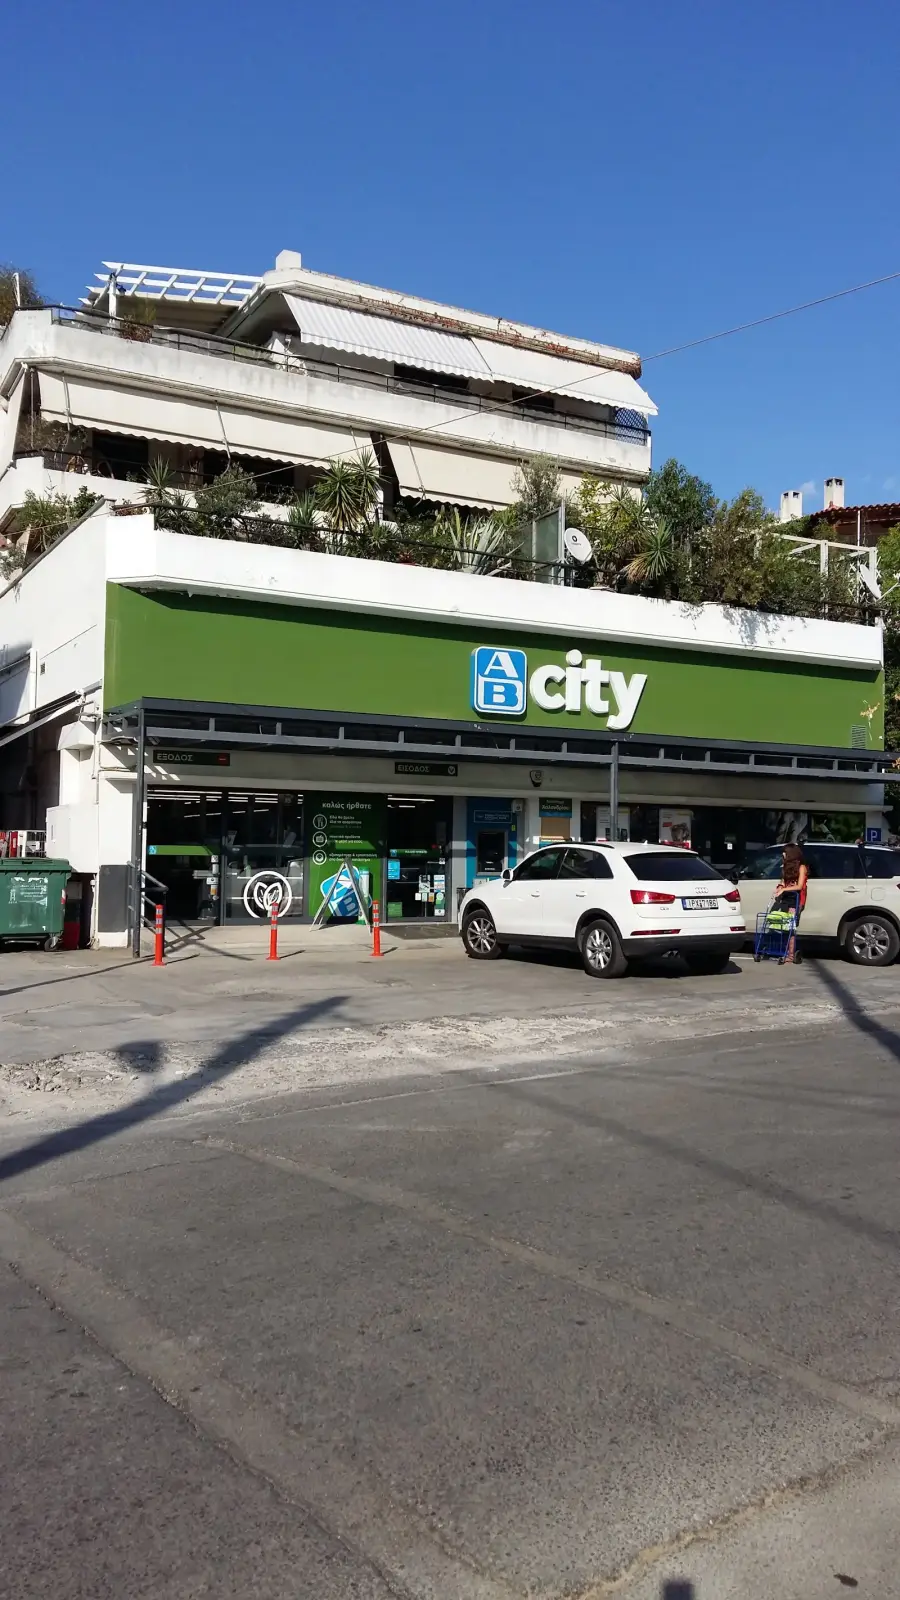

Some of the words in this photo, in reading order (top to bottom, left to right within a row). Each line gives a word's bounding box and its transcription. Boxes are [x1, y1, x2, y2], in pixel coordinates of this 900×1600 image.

[529, 649, 648, 730] city
[156, 753, 194, 762] ΕΞΟΔΟΣ
[397, 764, 430, 774] ΕΙΣΟΔΟΣ
[321, 801, 345, 810] καλώς
[346, 801, 372, 811] ήρθατε
[870, 830, 877, 842] P
